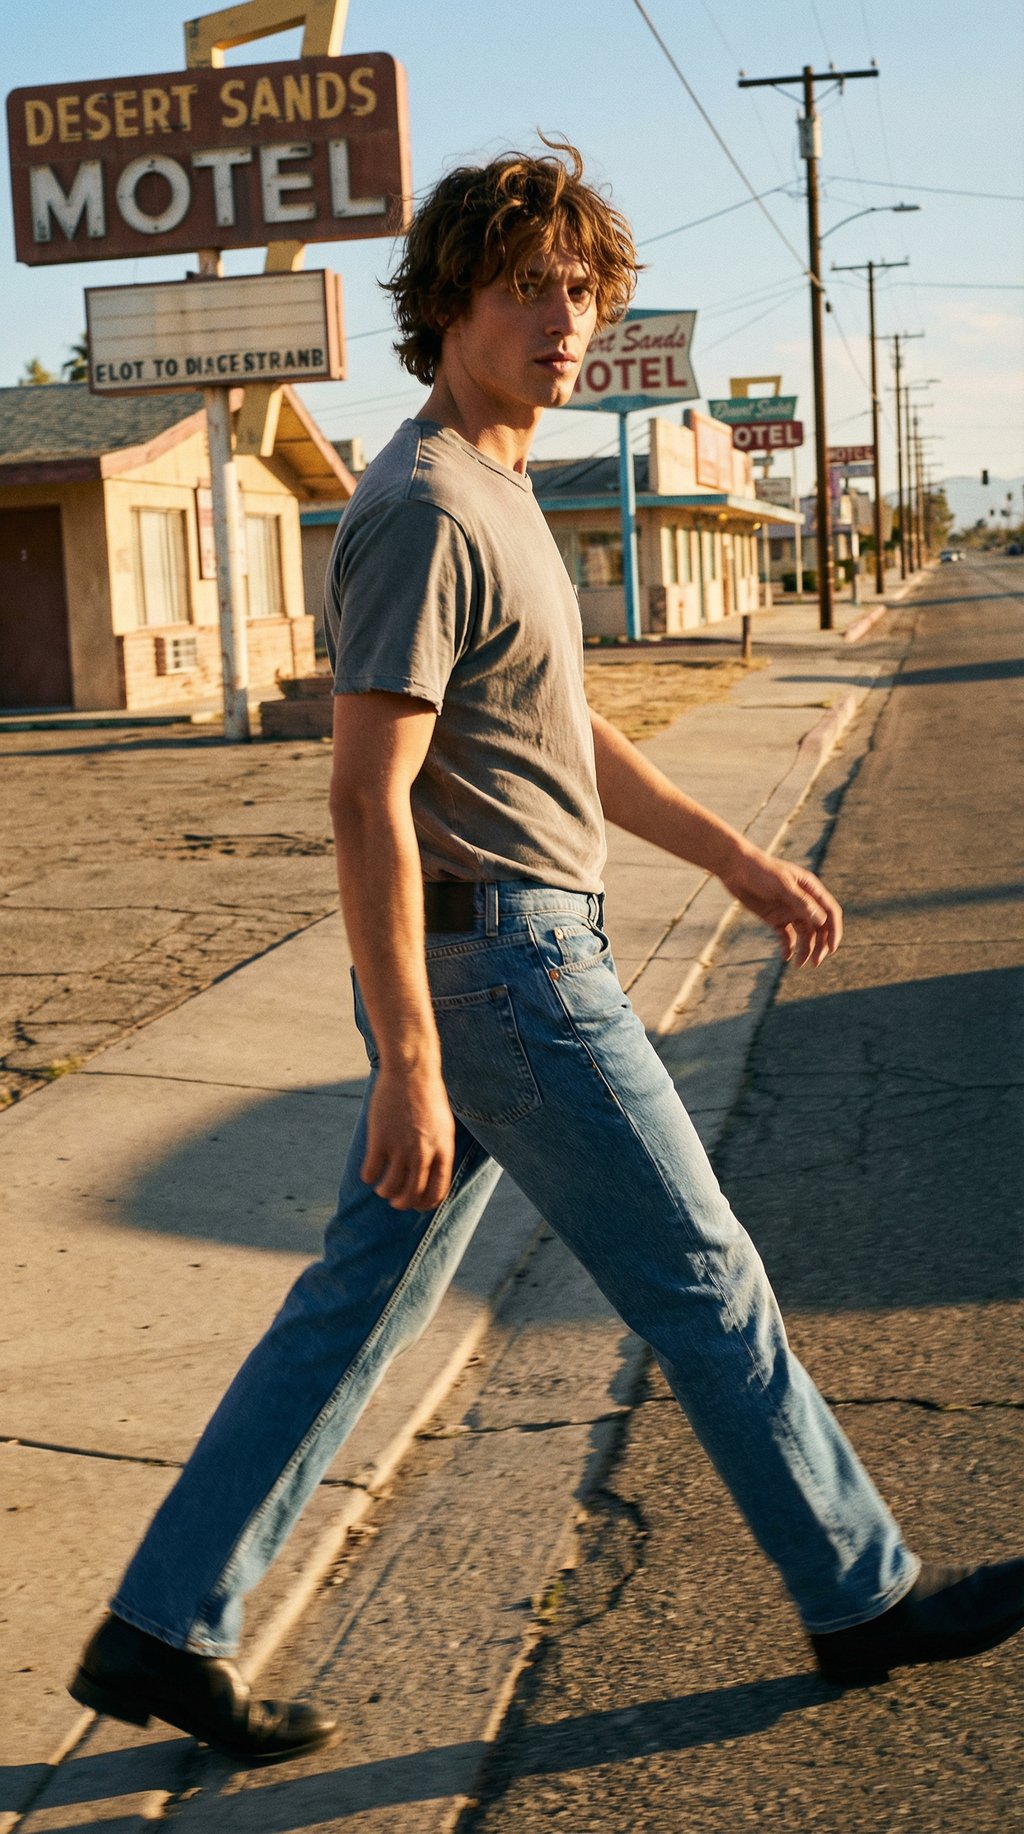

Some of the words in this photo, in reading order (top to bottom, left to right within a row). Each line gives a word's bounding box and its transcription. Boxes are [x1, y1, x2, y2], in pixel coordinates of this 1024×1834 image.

[24, 84, 199, 146] DESERT
[220, 67, 378, 129] SANDS
[29, 138, 388, 244] MOTEL
[621, 323, 686, 352] Sands
[95, 361, 144, 383] ELOT
[153, 358, 178, 377] TO
[734, 424, 800, 448] OTEL
